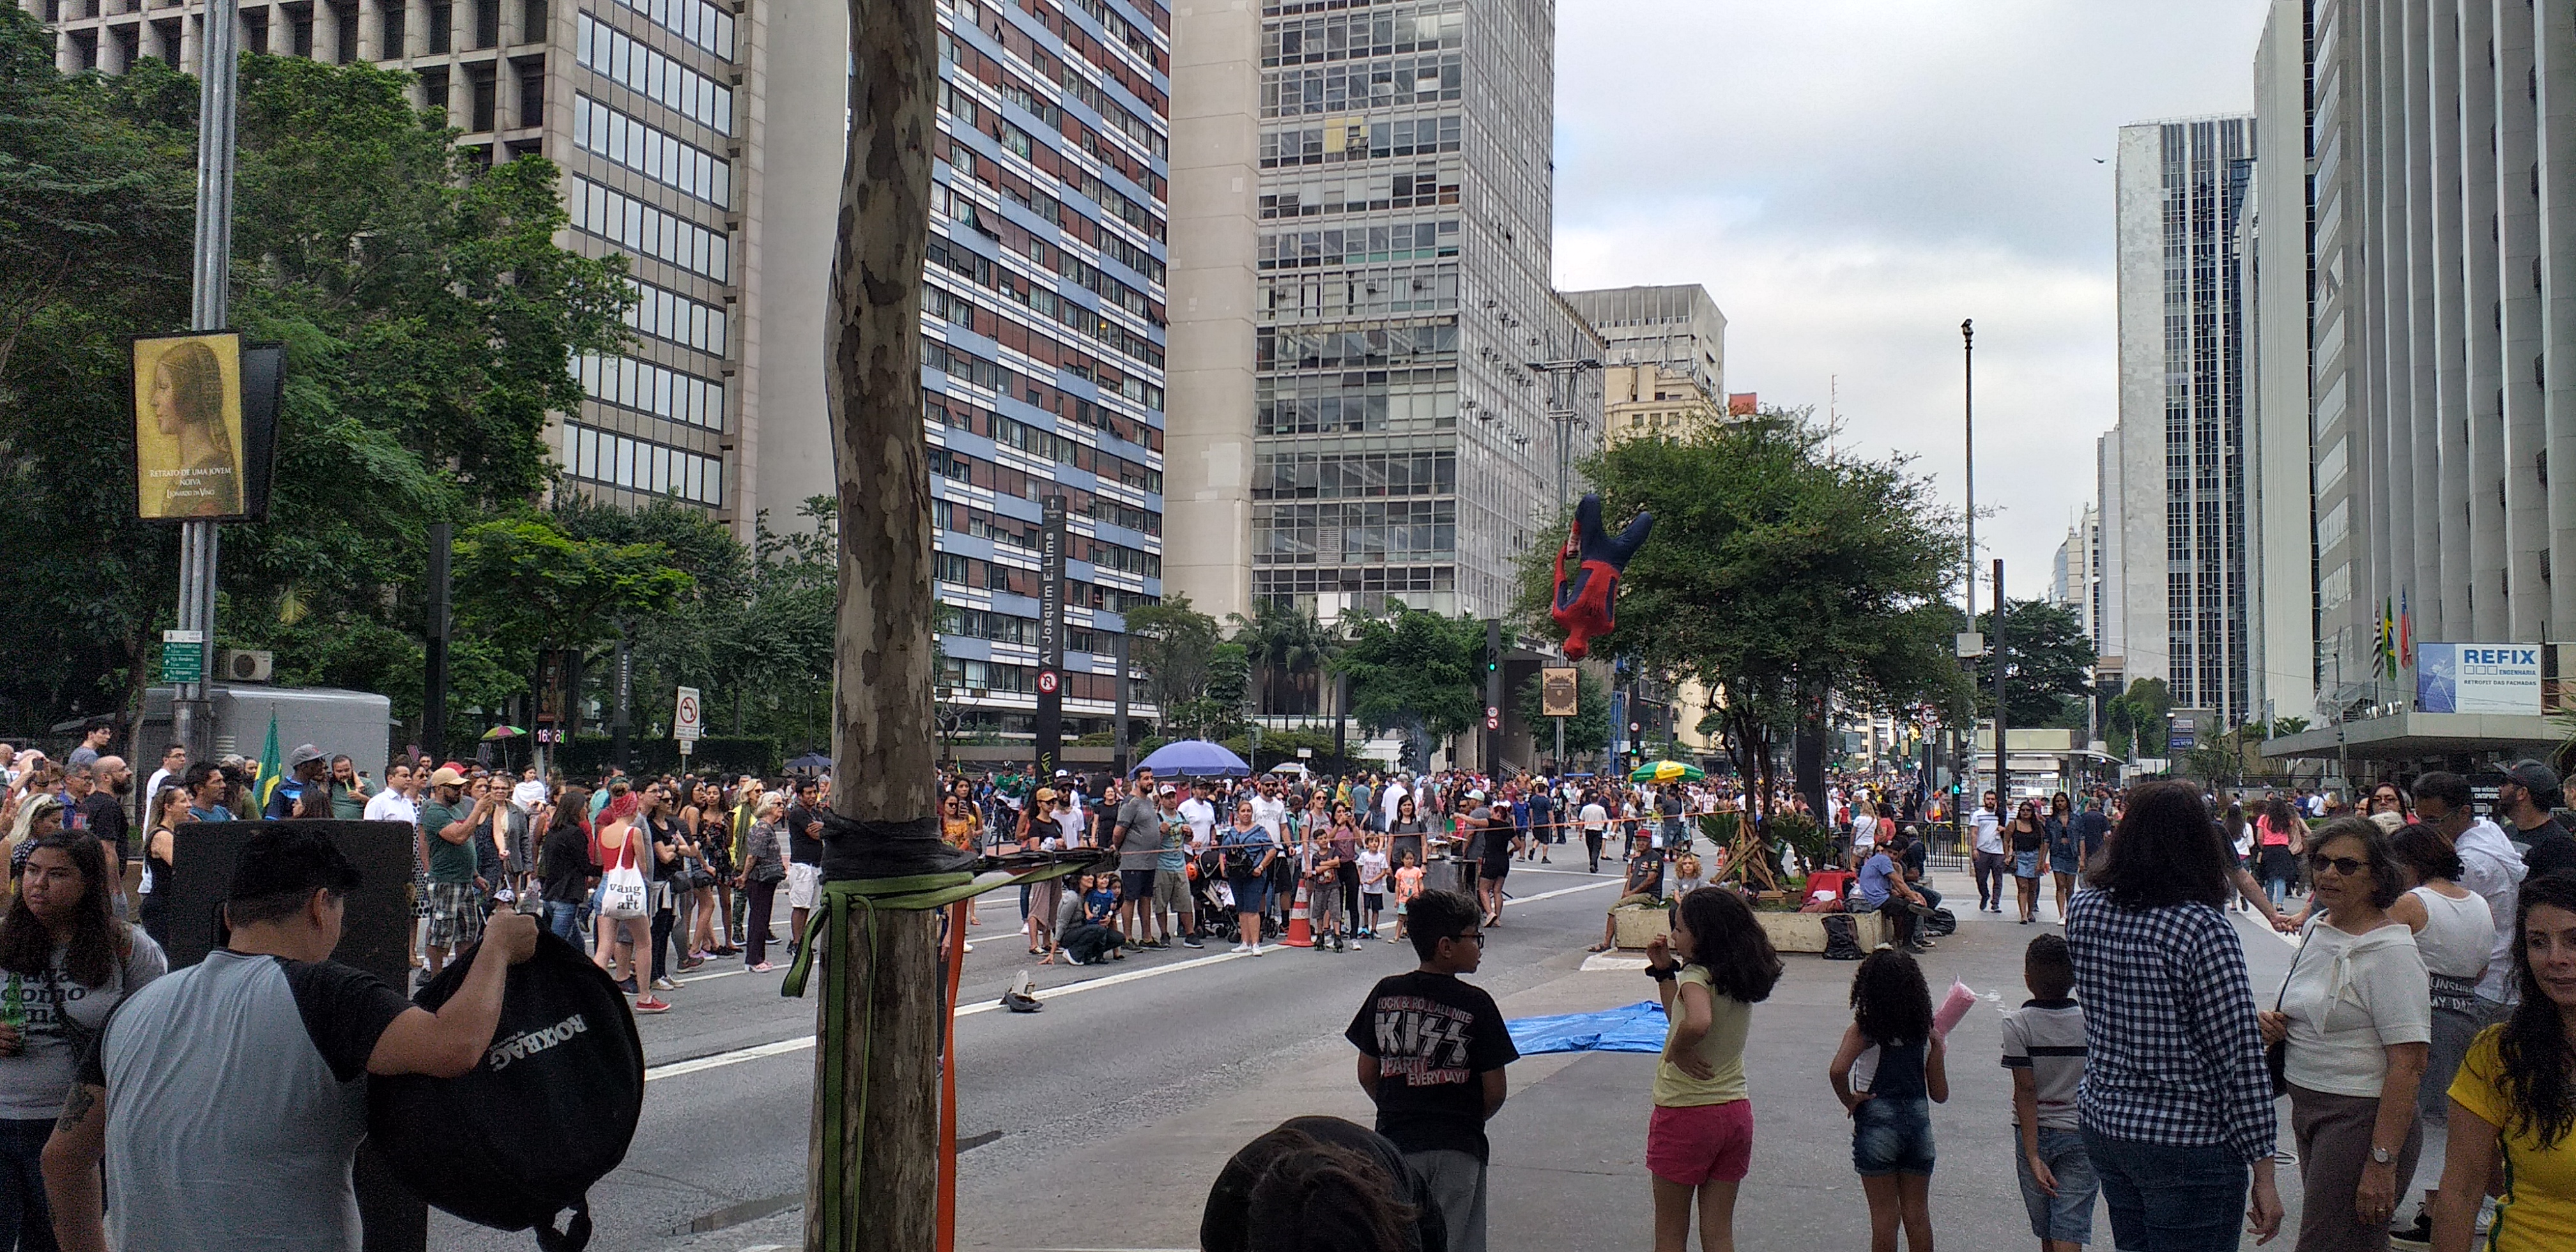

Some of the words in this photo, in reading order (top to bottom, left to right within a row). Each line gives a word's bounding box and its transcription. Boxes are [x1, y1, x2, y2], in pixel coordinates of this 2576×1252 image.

[192, 468, 208, 476] UMA
[209, 467, 231, 476] JOVEM
[1043, 533, 1054, 567] Lima
[1043, 569, 1054, 581] E.
[1041, 585, 1054, 644] Joaquim
[1041, 647, 1052, 665] Al.
[2464, 649, 2536, 664] REFIX
[617, 899, 640, 910] art
[1434, 1004, 1450, 1016] ALL
[1452, 1007, 1474, 1022] NITE
[1375, 1010, 1472, 1068] KISS
[1387, 1057, 1427, 1074] PARTY
[1409, 1070, 1441, 1085] EVERY
